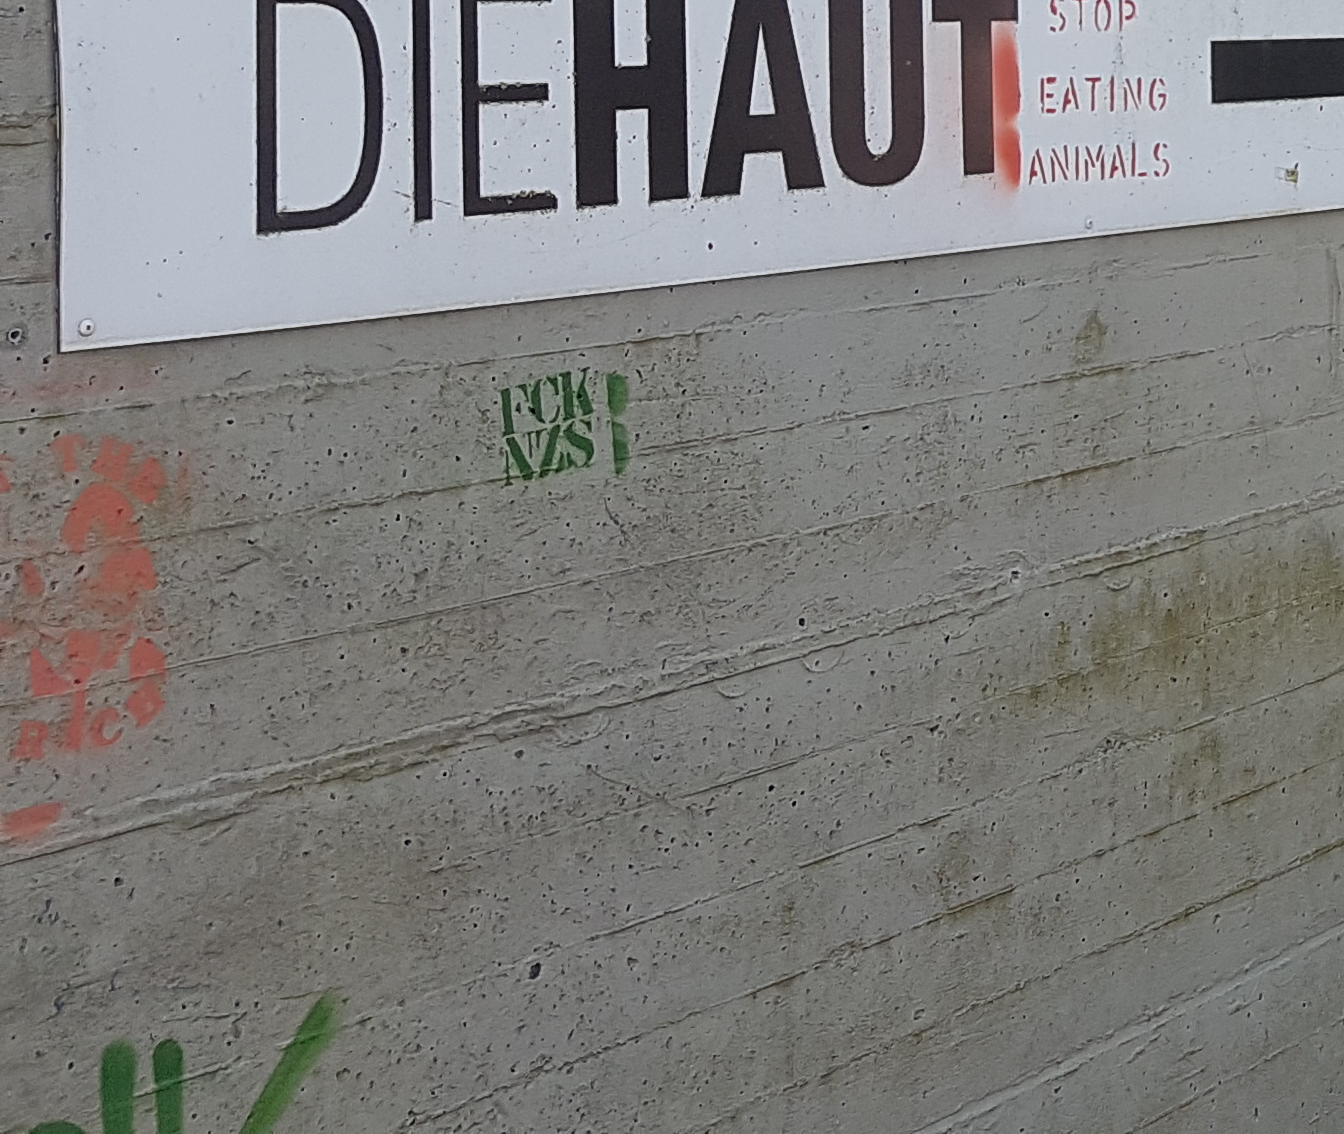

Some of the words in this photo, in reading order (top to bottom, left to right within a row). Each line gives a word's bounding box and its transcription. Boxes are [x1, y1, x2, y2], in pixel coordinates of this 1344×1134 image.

[1040, 75, 1167, 114] EATING
[1028, 141, 1170, 185] ANIMALS
[500, 367, 595, 438] FCK
[502, 419, 596, 487] NZS
